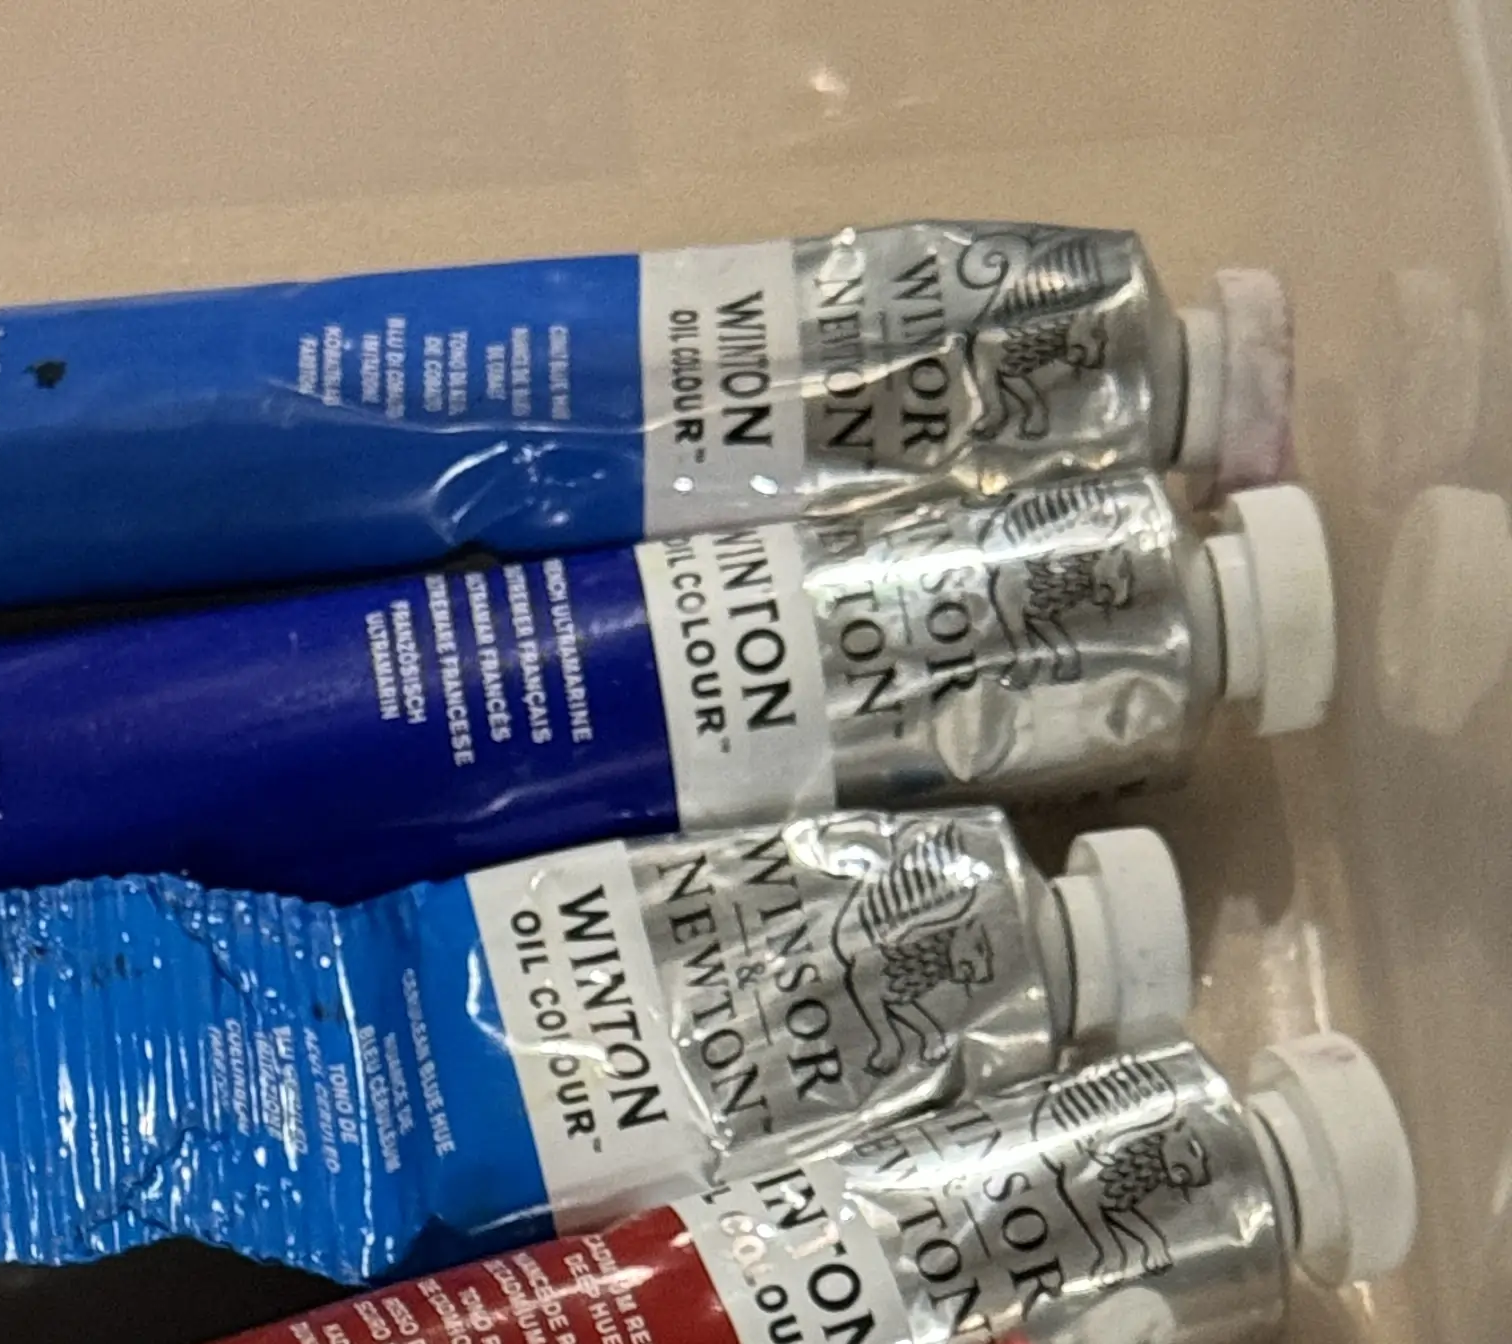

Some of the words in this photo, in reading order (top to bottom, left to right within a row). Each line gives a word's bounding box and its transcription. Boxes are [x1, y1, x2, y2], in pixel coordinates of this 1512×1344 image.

[716, 291, 774, 448] WINTON
[438, 655, 476, 767] FRANCESE
[517, 640, 554, 743] FRANÇAIS
[510, 909, 550, 975] OIL
[556, 884, 669, 1131] WINTON
[654, 853, 769, 1122] NEWTON
[734, 960, 768, 991] &
[739, 835, 844, 1102] WINSOR
